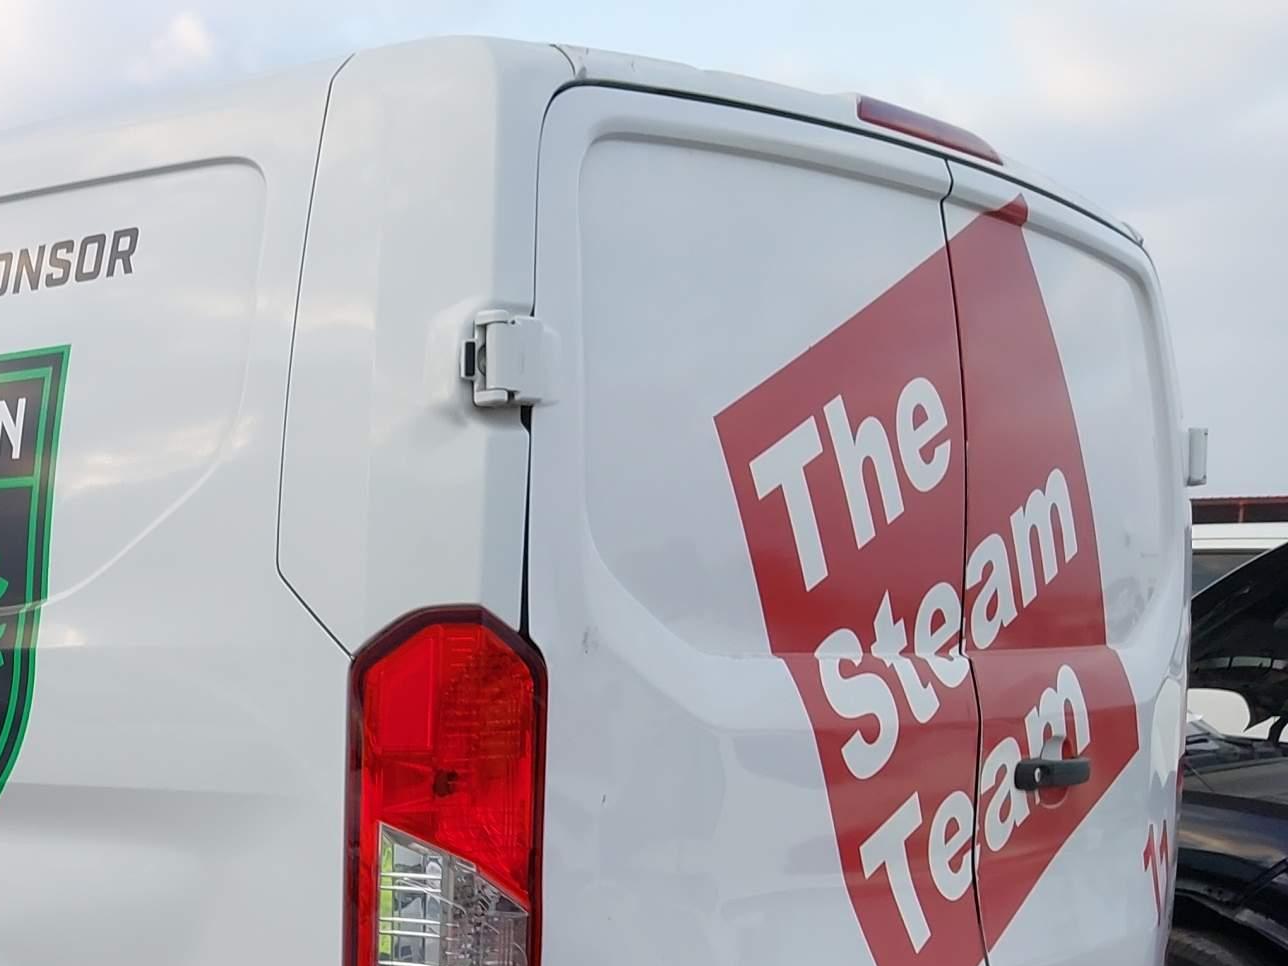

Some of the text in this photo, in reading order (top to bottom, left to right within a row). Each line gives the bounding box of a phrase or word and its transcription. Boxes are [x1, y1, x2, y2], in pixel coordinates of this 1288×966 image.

[749, 377, 951, 592] The
[814, 468, 1078, 780] Steam
[859, 664, 1091, 954] Team
